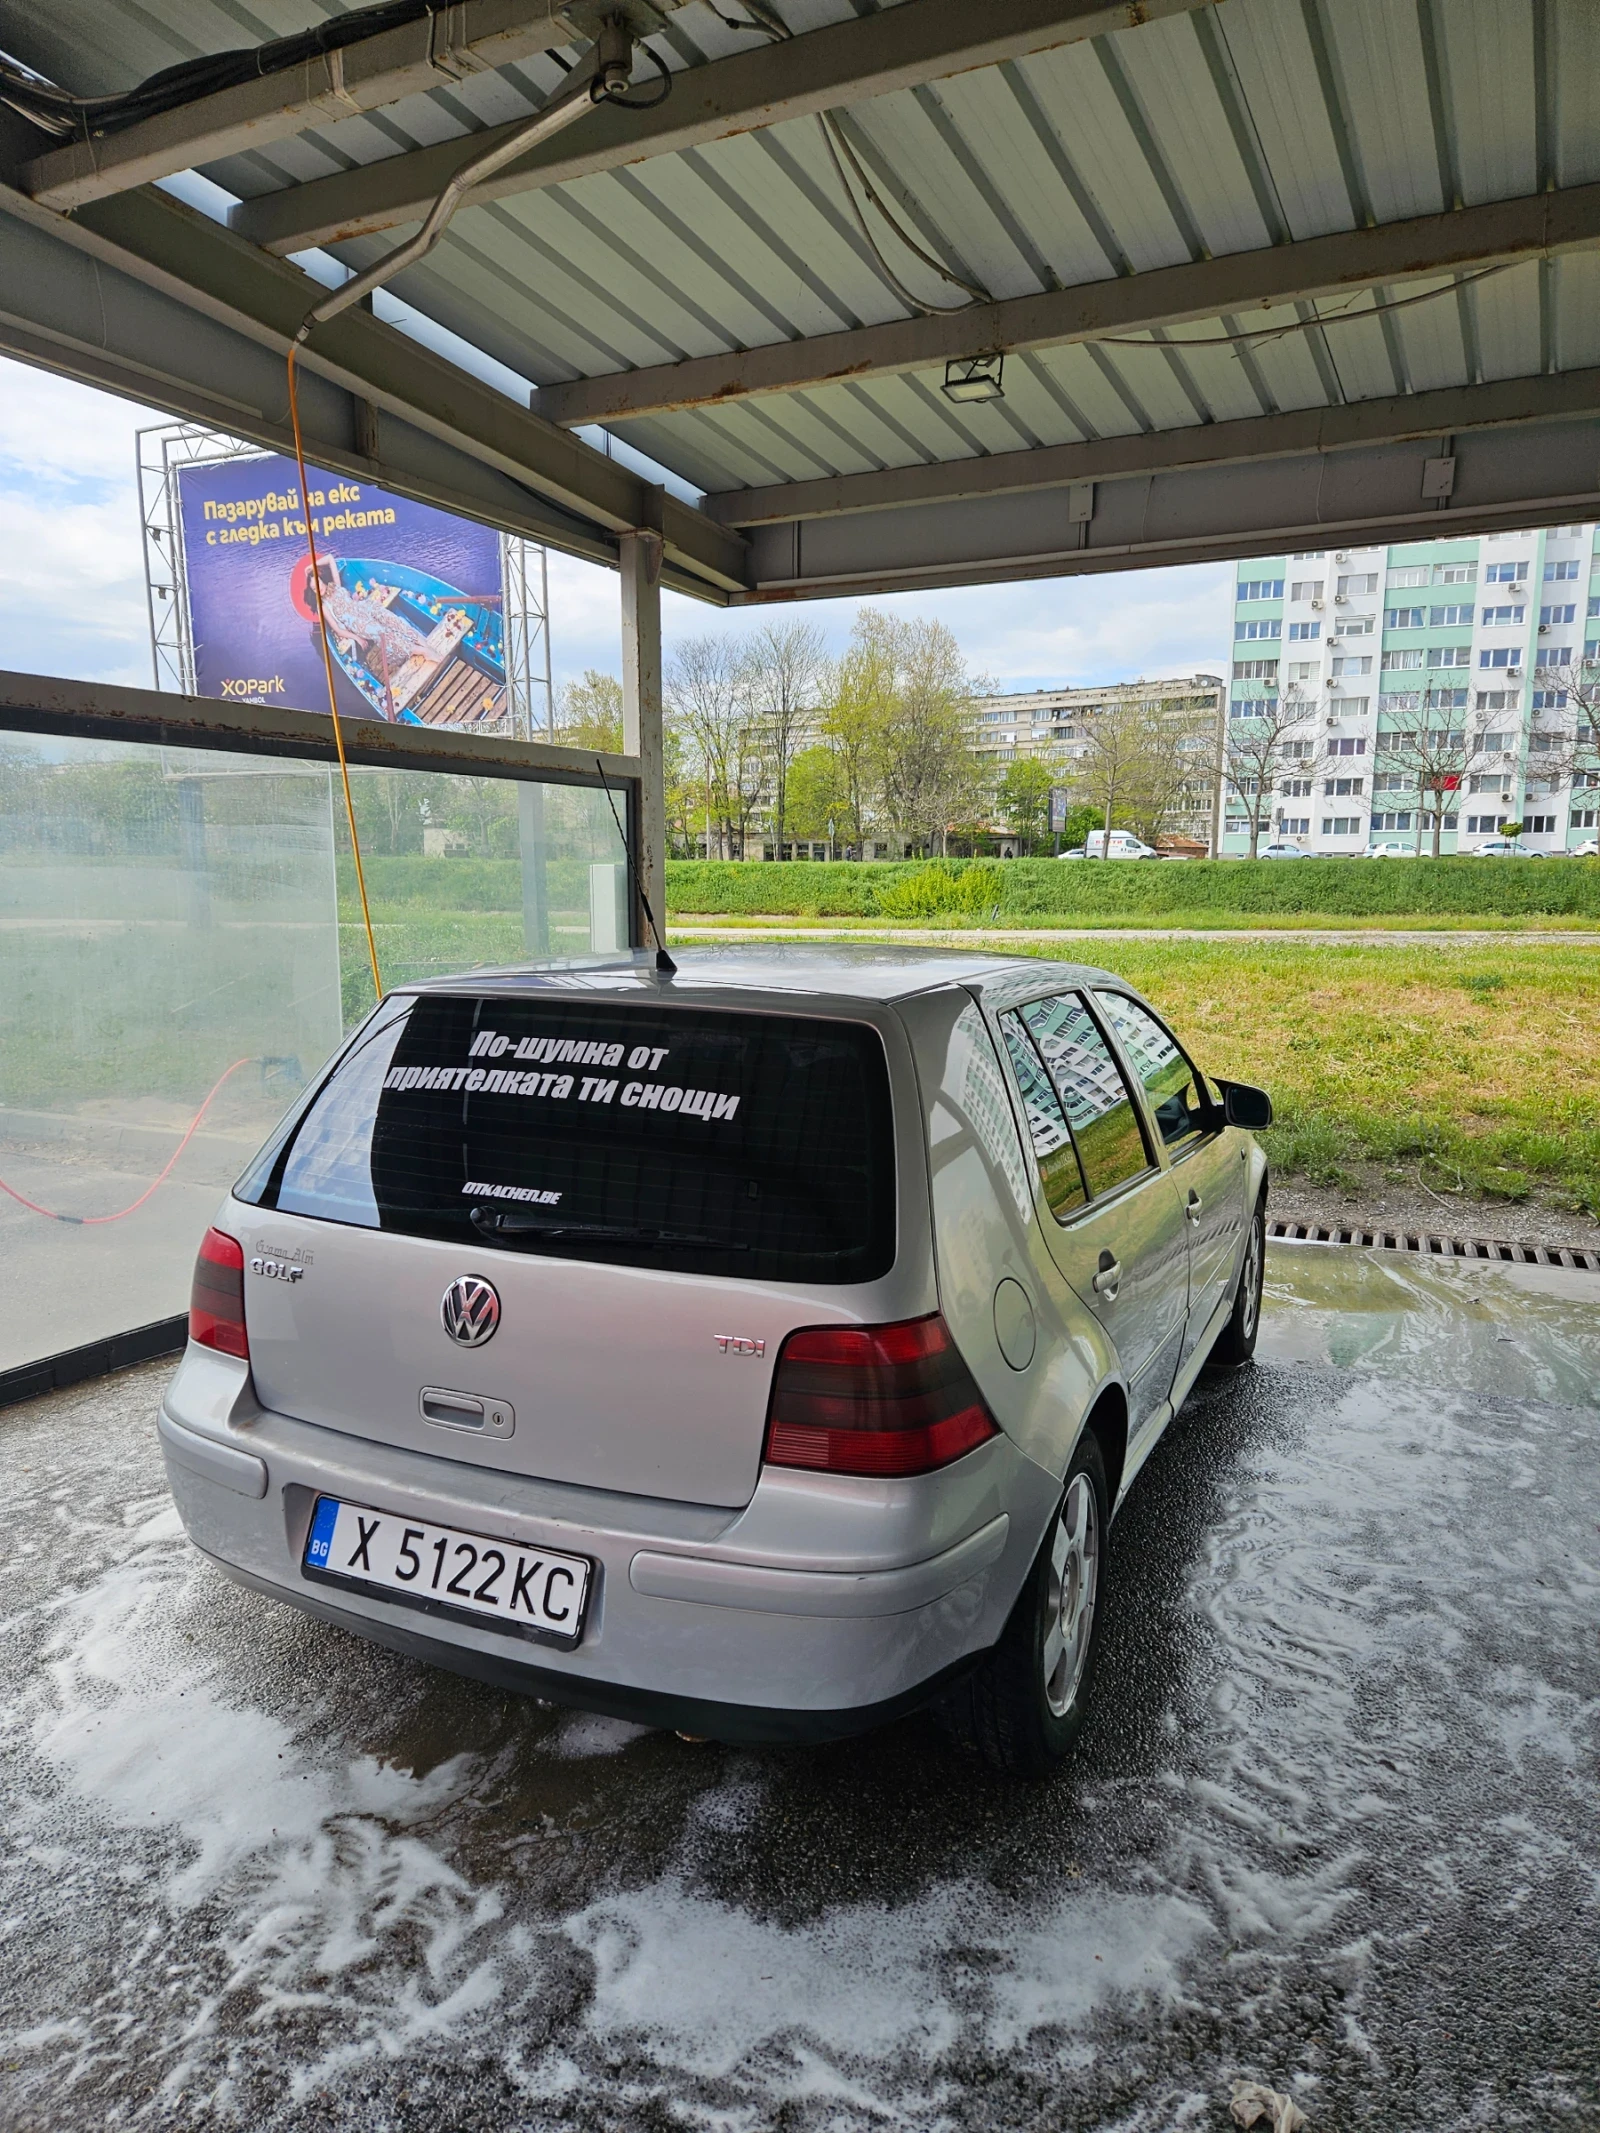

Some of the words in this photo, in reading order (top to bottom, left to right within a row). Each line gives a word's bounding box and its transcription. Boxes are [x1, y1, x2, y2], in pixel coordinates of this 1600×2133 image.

[203, 487, 299, 523] Пазарувай
[328, 483, 361, 504] екс
[206, 530, 217, 546] с
[219, 520, 280, 546] гледка
[323, 507, 396, 537] реката
[468, 1030, 625, 1067] По-шумна
[627, 1046, 670, 1071] от
[382, 1066, 575, 1099] приятелката
[577, 1076, 620, 1104] ти
[619, 1081, 741, 1122] снощи
[249, 1257, 304, 1284] GOLF
[713, 1333, 766, 1359] TDI
[310, 1538, 329, 1557] BG
[347, 1516, 381, 1572] X
